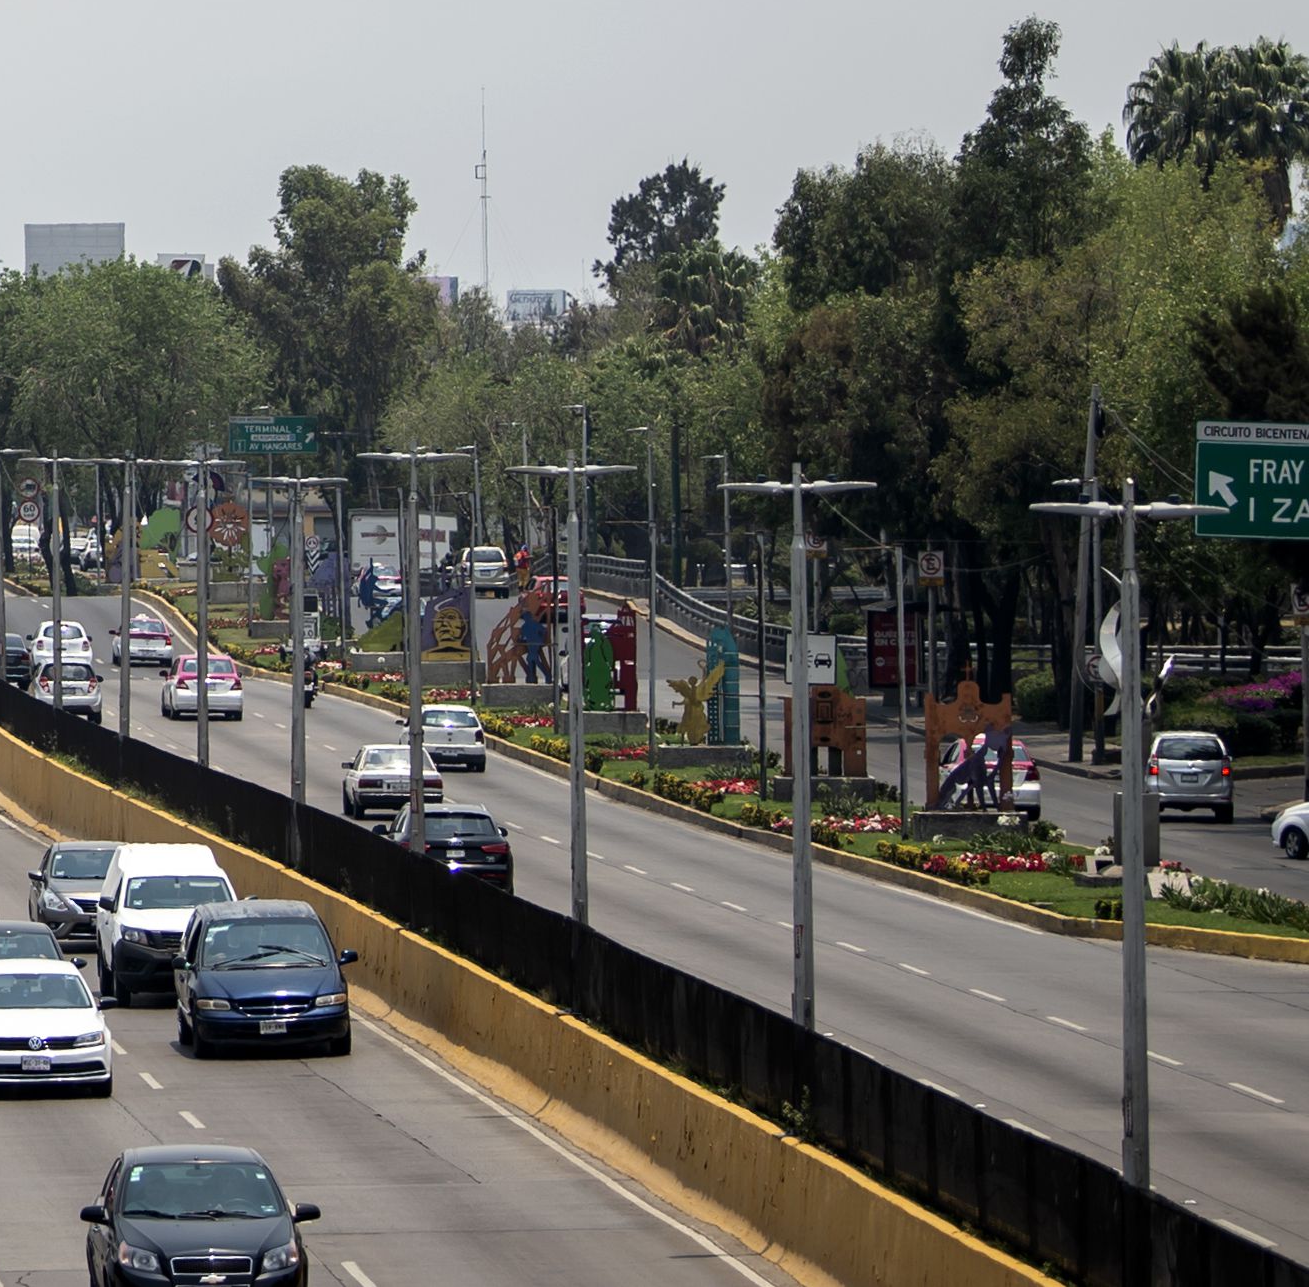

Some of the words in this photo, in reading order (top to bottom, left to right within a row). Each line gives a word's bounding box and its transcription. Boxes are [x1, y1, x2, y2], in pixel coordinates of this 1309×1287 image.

[244, 425, 291, 433] TERMINAL
[295, 425, 303, 433] 2
[1204, 425, 1251, 437] CIRCUITO
[262, 443, 303, 451] HANGARES
[1249, 459, 1305, 484] FRAY
[23, 504, 36, 513] 60
